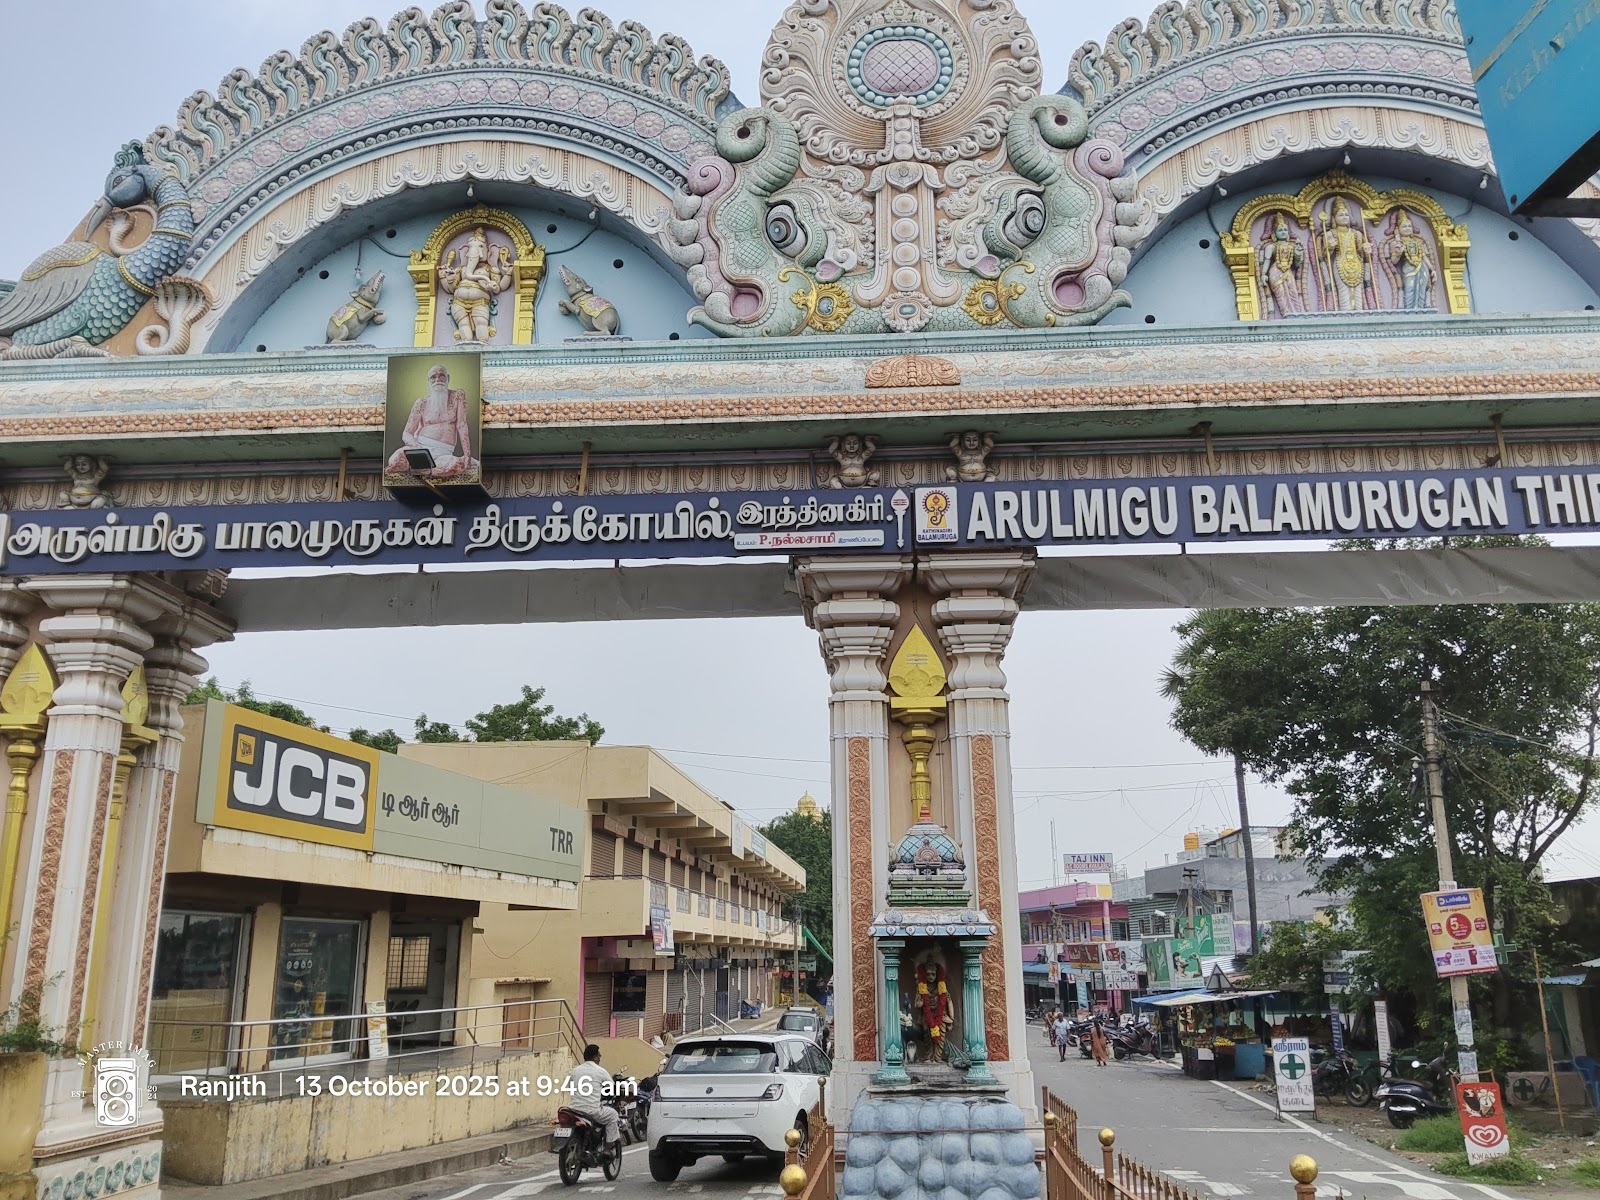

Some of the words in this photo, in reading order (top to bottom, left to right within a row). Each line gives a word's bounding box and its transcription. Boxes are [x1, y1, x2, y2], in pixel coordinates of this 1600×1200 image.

[966, 486, 1179, 539] ARULMIGU
[1192, 477, 1509, 534] BALAMURUGAN
[7, 512, 205, 563] அருள்மிகு
[215, 504, 457, 558] பாலமுருகன்
[232, 740, 367, 826] JCB
[381, 790, 396, 818] டி
[398, 796, 431, 824] ஆர்
[431, 802, 461, 829] ஆர்
[549, 826, 574, 855] TRR
[1070, 855, 1087, 863] TAJ
[1089, 854, 1106, 862] INN
[1449, 917, 1460, 931] 5
